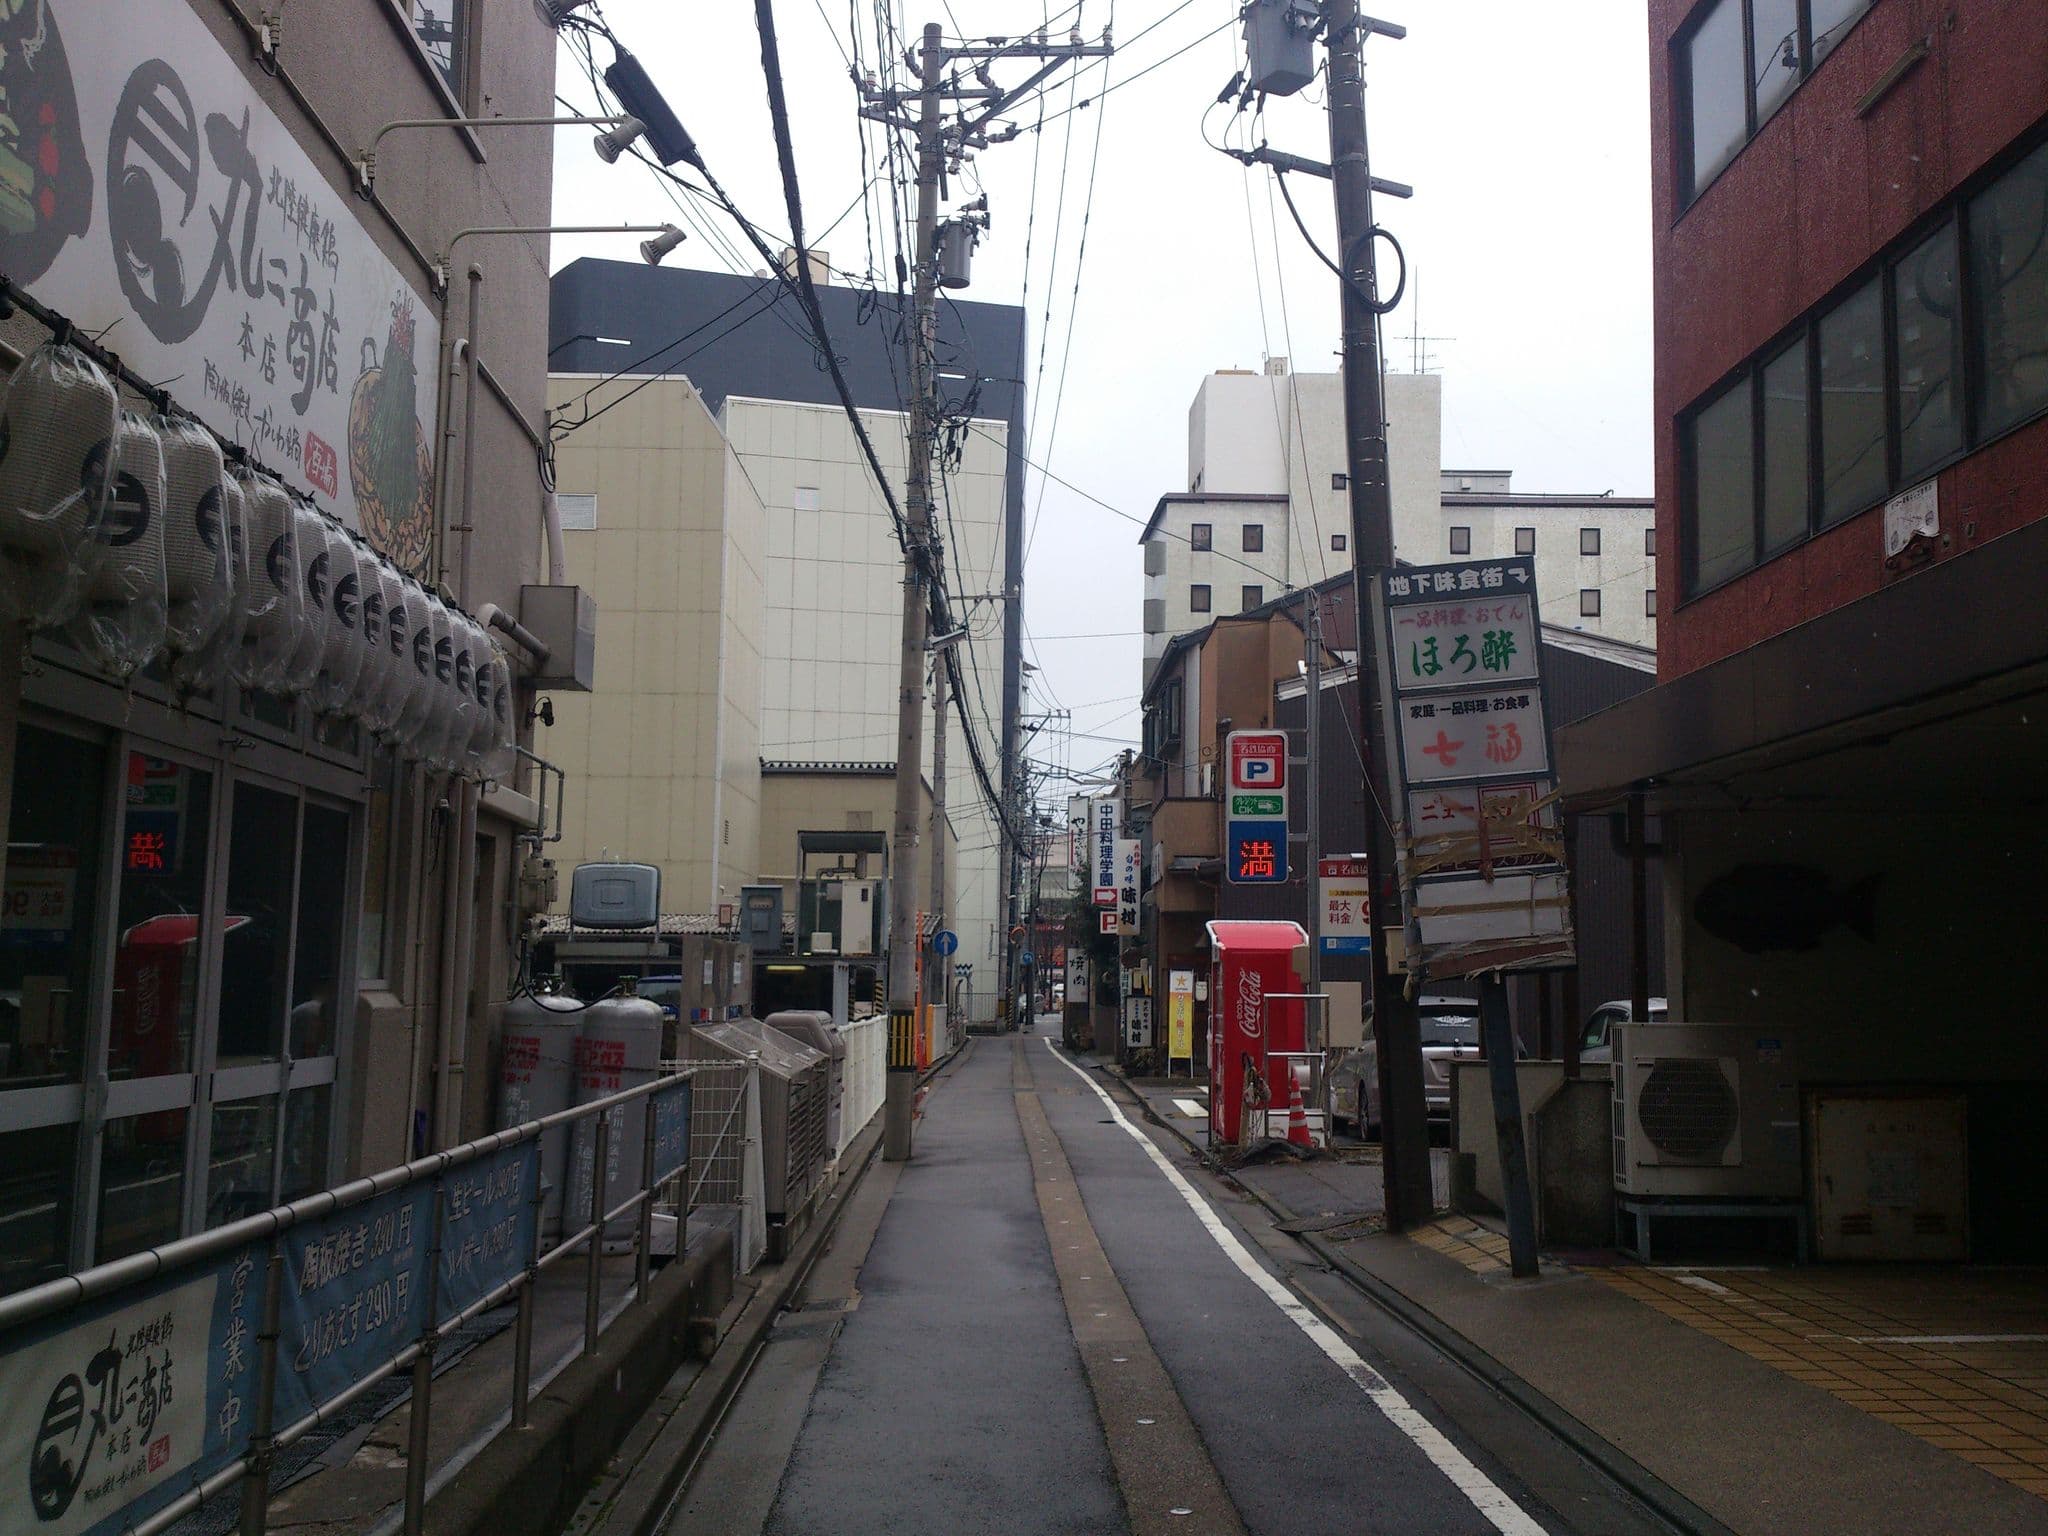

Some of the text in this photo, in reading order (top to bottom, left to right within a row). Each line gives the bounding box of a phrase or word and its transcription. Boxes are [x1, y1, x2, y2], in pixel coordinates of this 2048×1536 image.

[237, 312, 277, 385] 本店
[1388, 567, 1504, 596] 地下味食街
[1412, 629, 1518, 677] ほろ酔
[1246, 761, 1269, 779] P
[1238, 806, 1253, 814] OK
[1099, 803, 1114, 887] 中田料理学園
[1240, 841, 1275, 877] 満
[1329, 900, 1351, 912] 最大
[1329, 913, 1351, 925] 料金
[1069, 955, 1087, 986] 焼肉
[219, 1250, 254, 1452] 営業中
